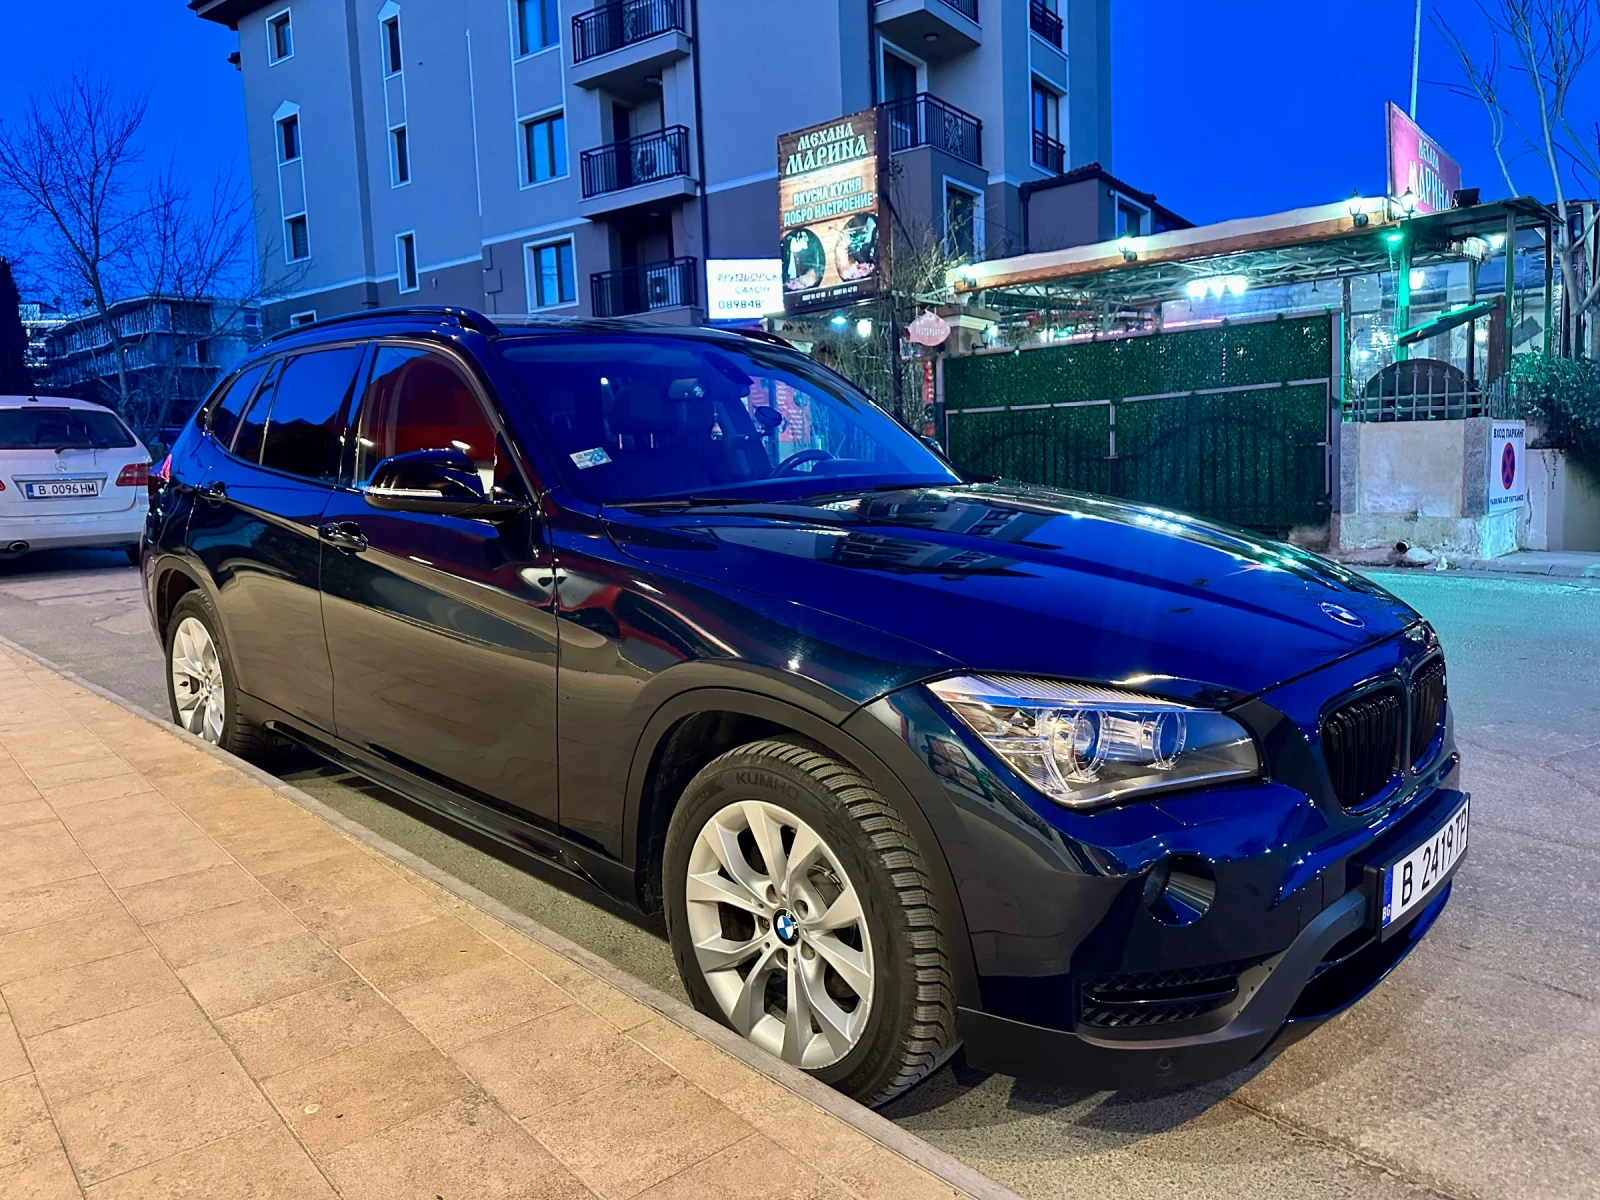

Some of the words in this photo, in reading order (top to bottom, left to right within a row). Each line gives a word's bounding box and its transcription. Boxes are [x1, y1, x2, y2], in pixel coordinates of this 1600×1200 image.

[797, 122, 854, 151] МЕХАНА
[785, 134, 869, 176] МАРИНА
[793, 186, 828, 207] ВКУСНА
[829, 176, 862, 200] КУХНЯ
[783, 207, 813, 227] ДОБРО
[814, 192, 874, 219] НАСТРОЕНИЕ
[718, 300, 765, 309] 089848
[1493, 428, 1506, 440] ВХОД
[1506, 428, 1525, 438] ПАРКИНГ
[52, 484, 79, 495] 0096
[1490, 497, 1503, 505] PARKING
[735, 772, 800, 801] KUMHO
[1401, 860, 1413, 907] B
[1421, 825, 1454, 891] 2419
[1382, 905, 1391, 921] BG
